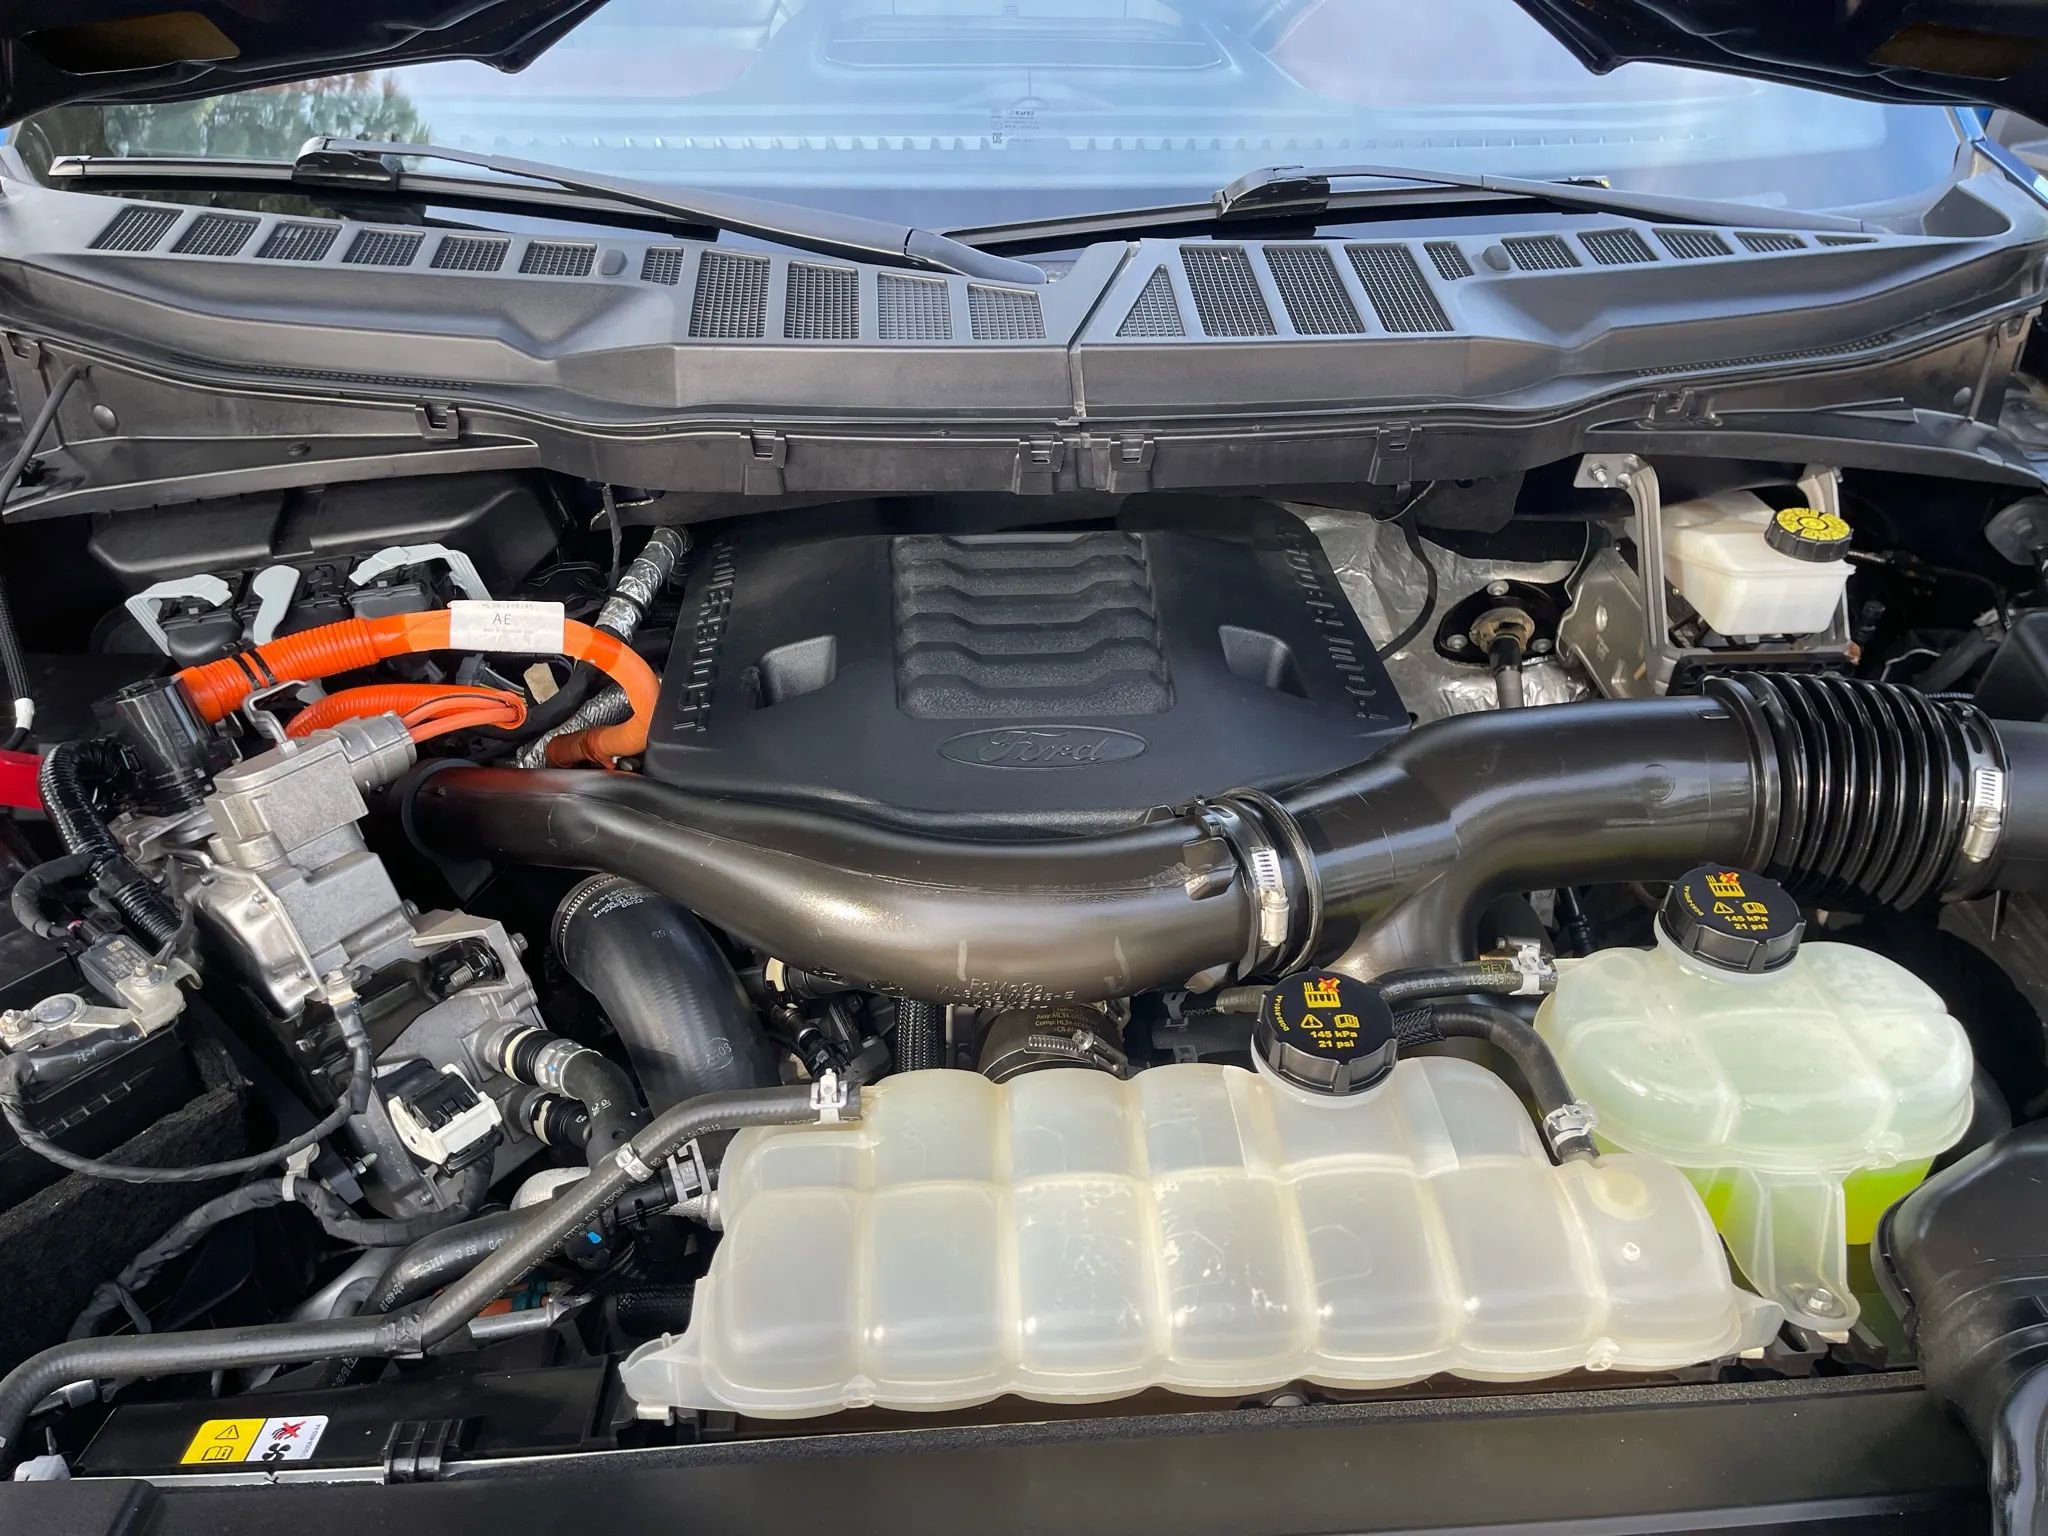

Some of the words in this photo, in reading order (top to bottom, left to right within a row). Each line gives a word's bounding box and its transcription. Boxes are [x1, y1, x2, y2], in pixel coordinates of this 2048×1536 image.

[492, 613, 512, 626] AE
[976, 730, 1112, 763] Ford
[1724, 915, 1746, 923] 145
[1746, 915, 1769, 923] kPa
[1751, 923, 1769, 931] psi
[1480, 963, 1508, 975] HEV
[970, 978, 1046, 994] FoMoCo
[1310, 1030, 1333, 1038] 145
[1335, 1030, 1358, 1038] kPa
[1318, 1040, 1333, 1048] 21
[1336, 1040, 1355, 1049] psi
